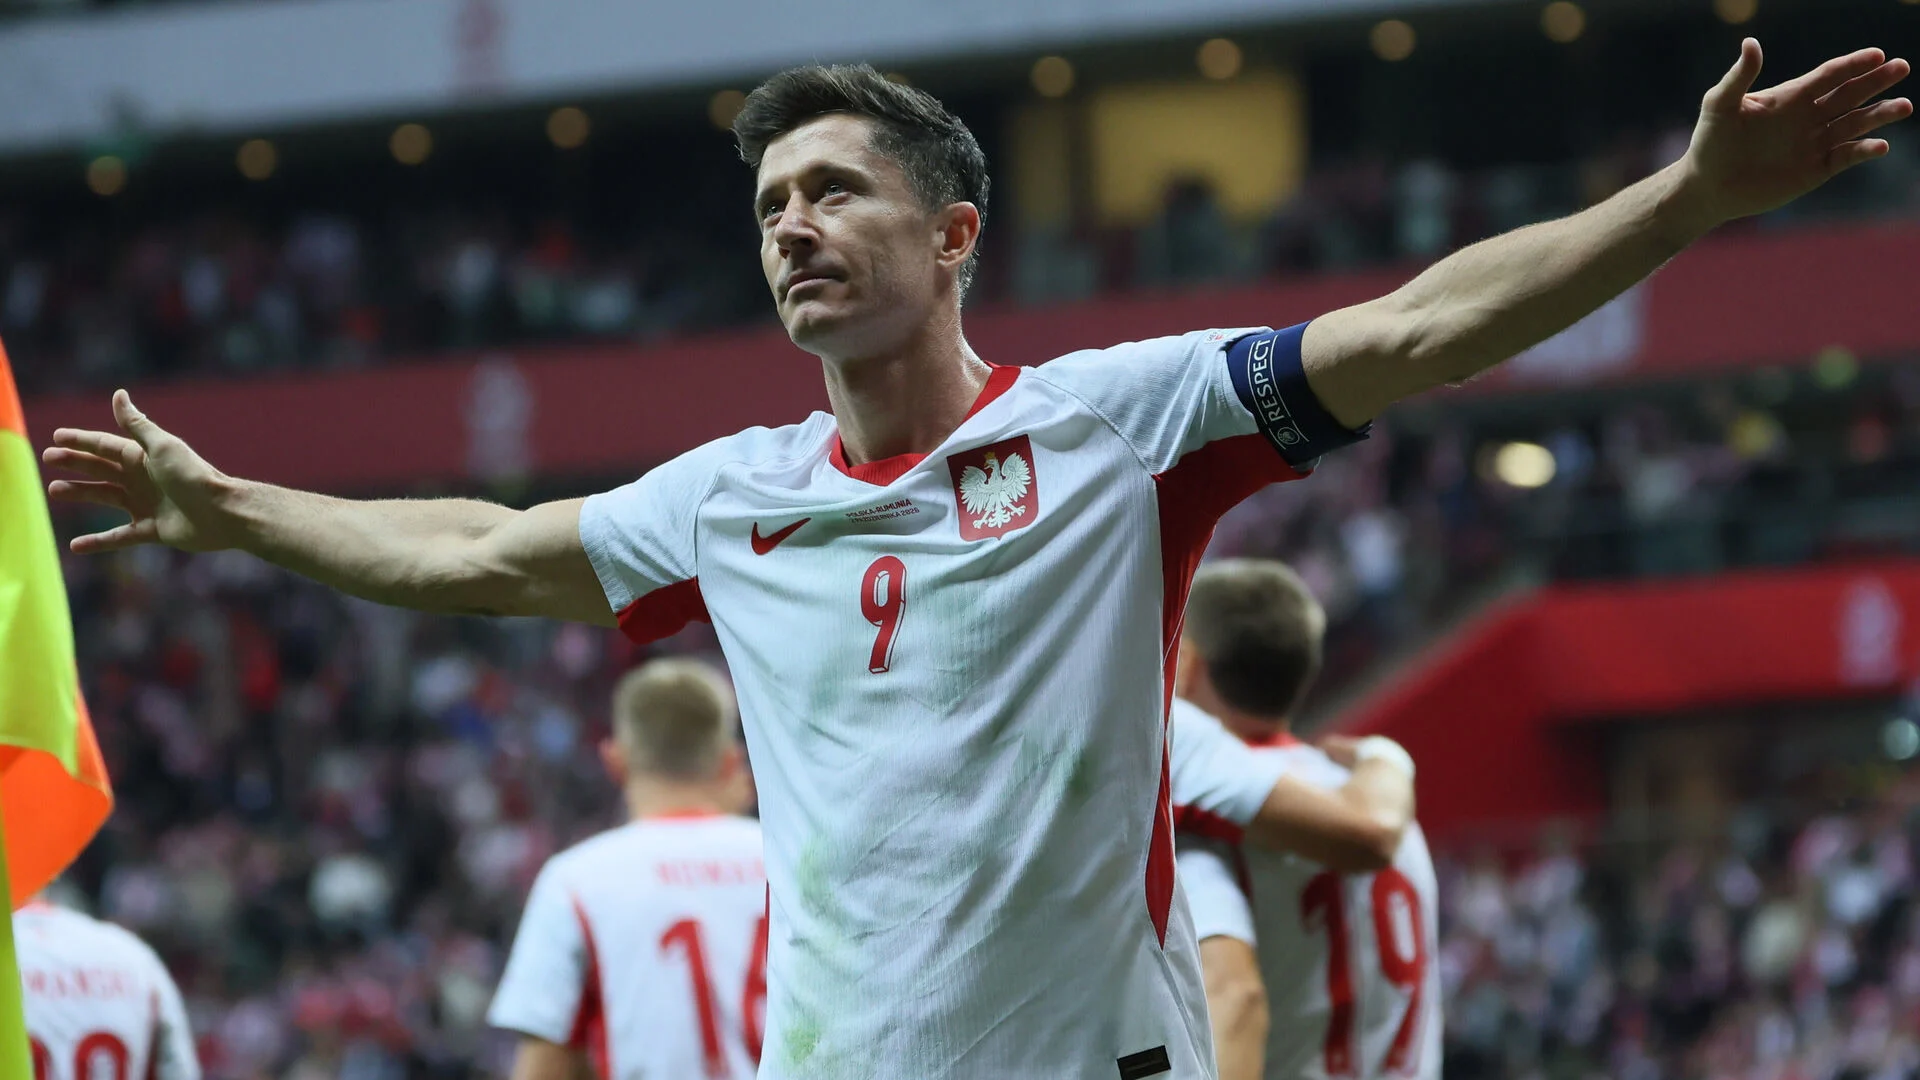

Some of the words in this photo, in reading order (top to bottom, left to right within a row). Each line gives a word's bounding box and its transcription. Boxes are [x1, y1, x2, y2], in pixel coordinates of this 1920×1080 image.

[1253, 340, 1285, 422] RESPECT
[860, 555, 907, 674] 9
[1300, 866, 1425, 1079] 19
